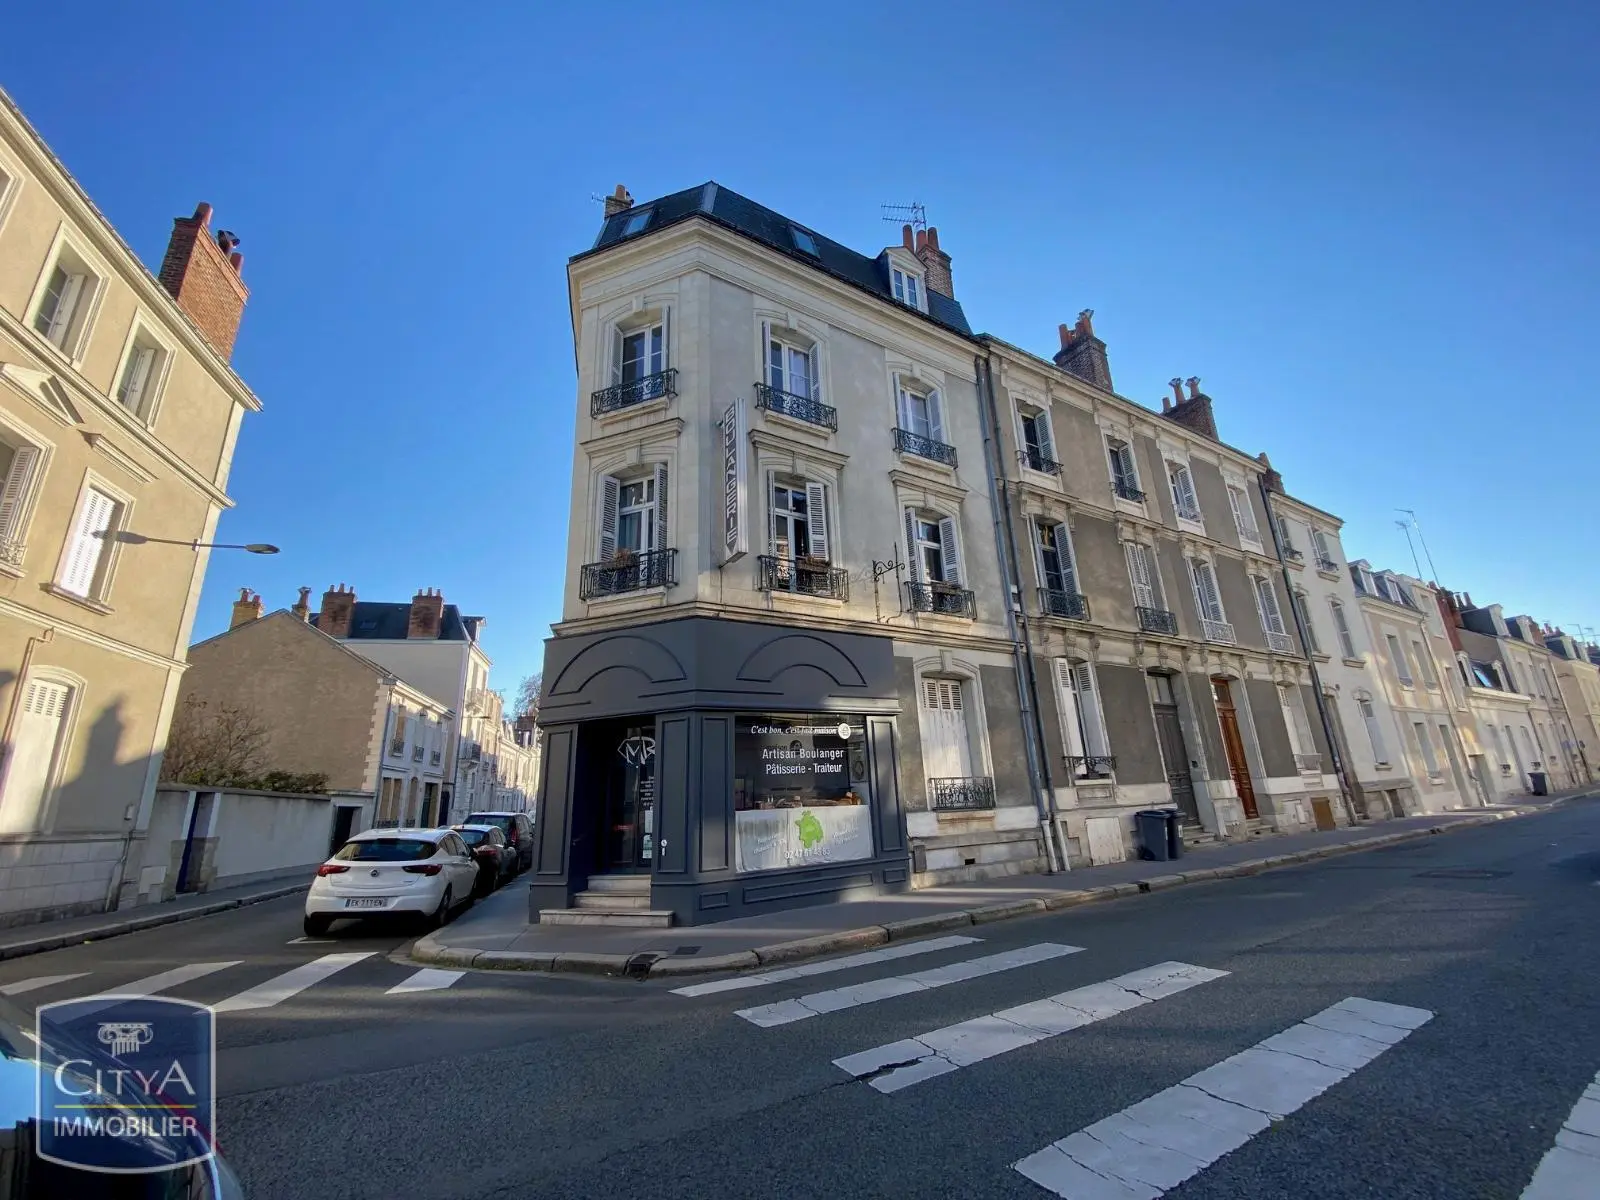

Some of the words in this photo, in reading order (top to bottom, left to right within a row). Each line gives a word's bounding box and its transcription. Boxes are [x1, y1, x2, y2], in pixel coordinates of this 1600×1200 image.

[725, 406, 737, 545] BOULANGERIE
[751, 725, 767, 734] C'est
[769, 725, 783, 735] bon,
[762, 748, 796, 759] Artisan
[799, 748, 844, 760] Boulanger
[766, 763, 806, 775] Pâtisserie
[813, 762, 842, 773] Traiteur
